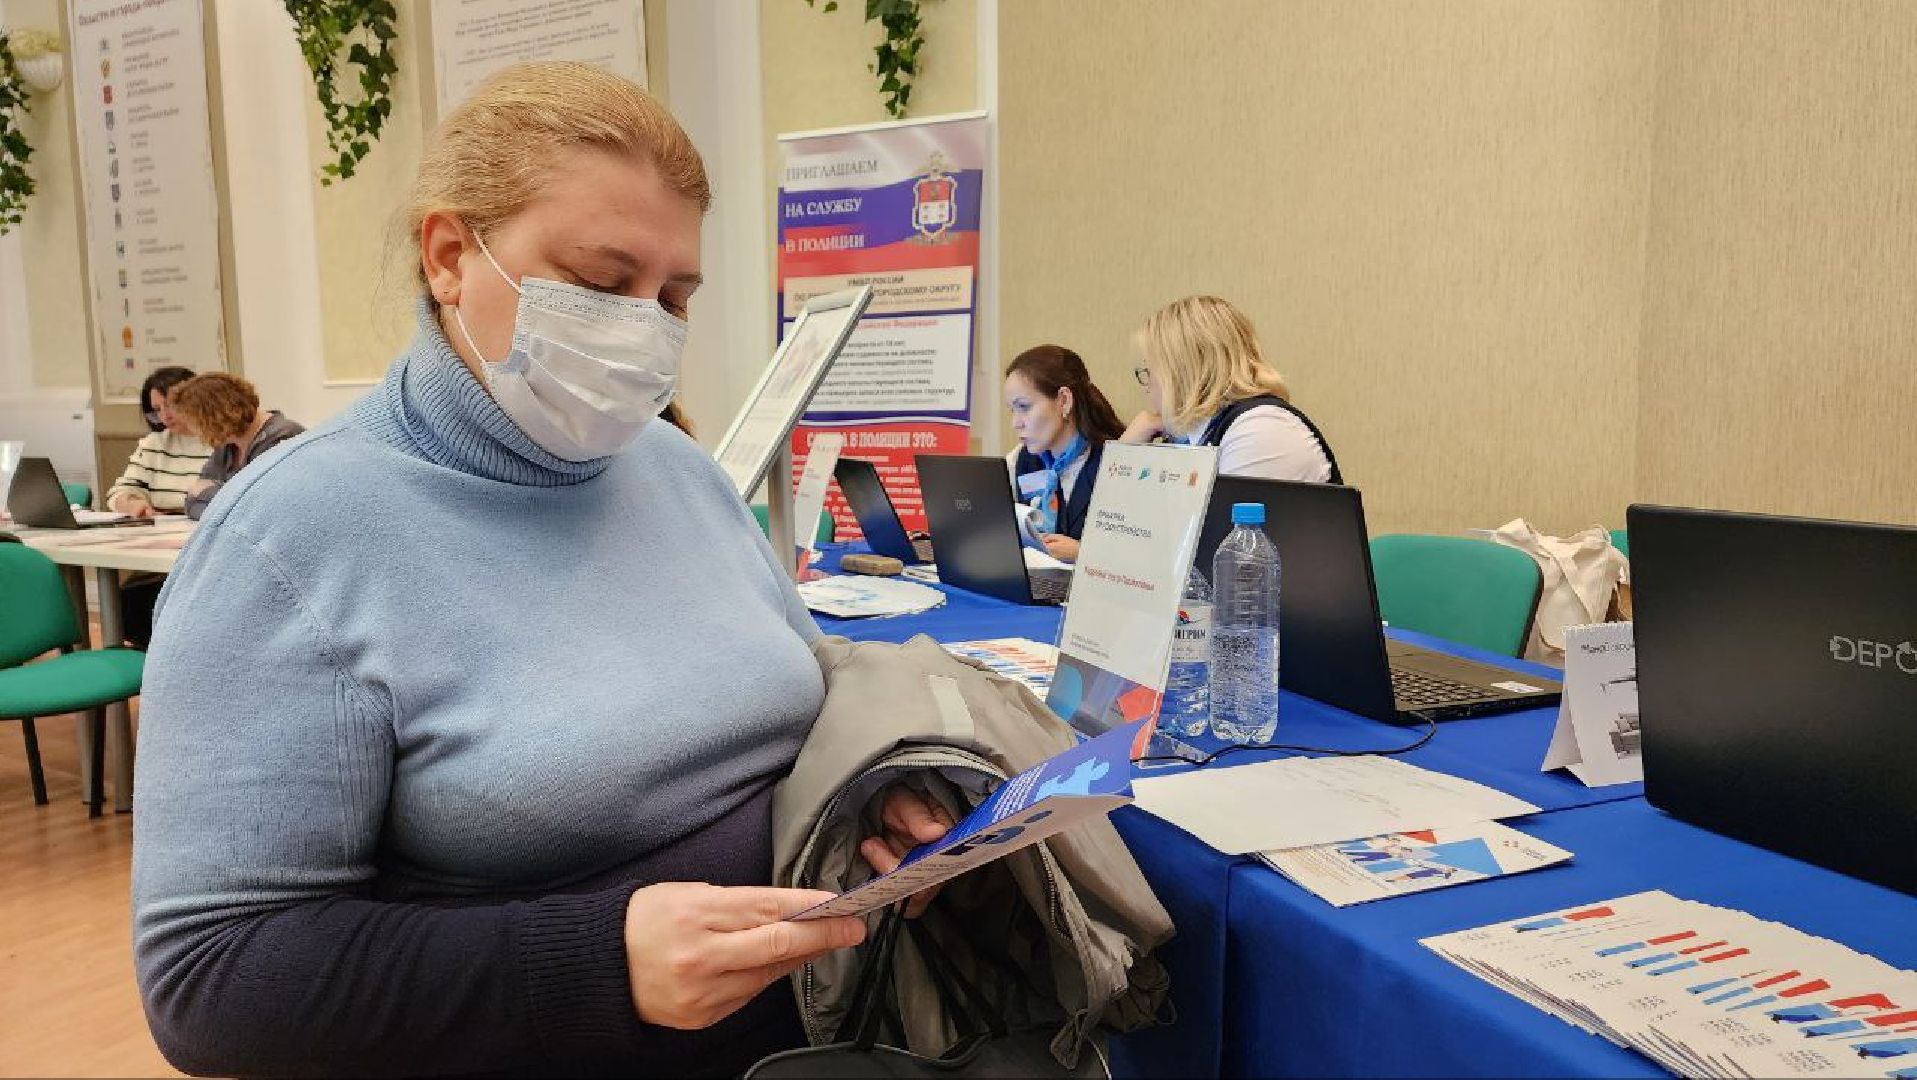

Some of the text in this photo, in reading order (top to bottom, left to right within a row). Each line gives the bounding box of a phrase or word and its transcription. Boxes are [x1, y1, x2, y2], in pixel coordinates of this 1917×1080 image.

[786, 159, 878, 181] ПРИГЛАШАЕМ
[785, 197, 863, 218] НА СЛУЖБУ
[785, 234, 865, 252] В ПОЛИЦИИ
[850, 432, 858, 447] В
[859, 431, 911, 449] ПОЛИЦИИ
[912, 432, 938, 447] ЭТО:
